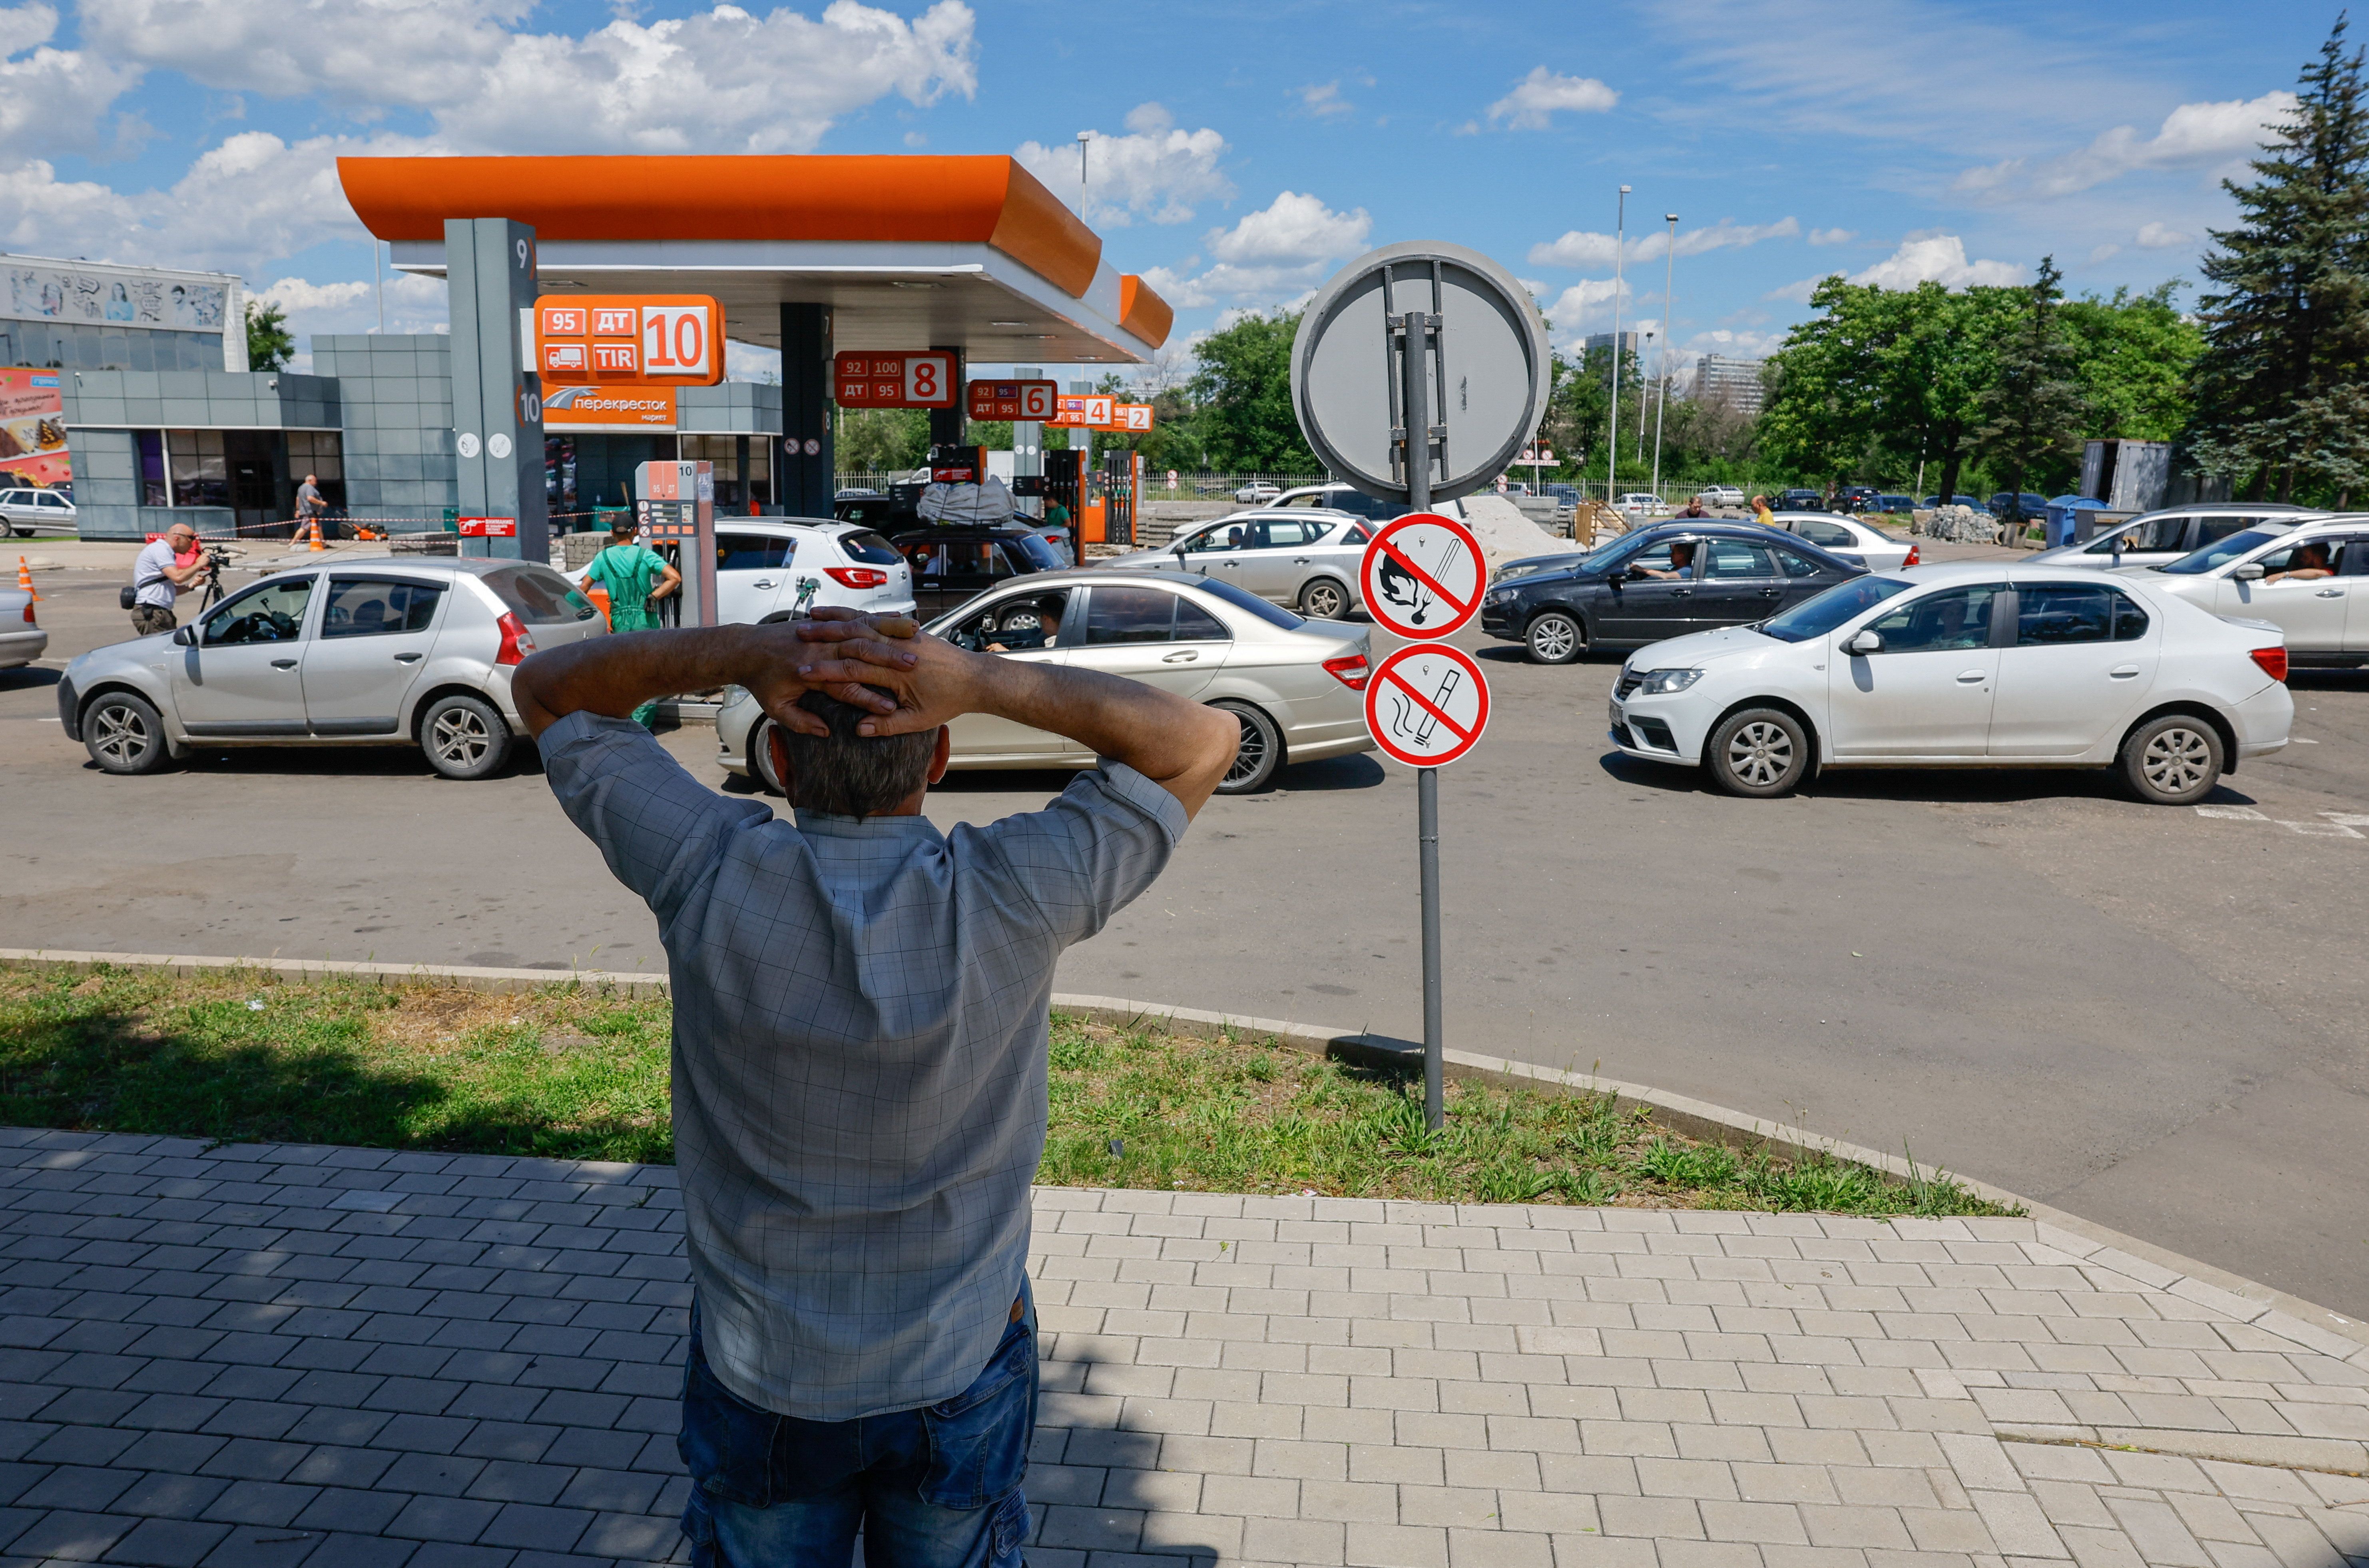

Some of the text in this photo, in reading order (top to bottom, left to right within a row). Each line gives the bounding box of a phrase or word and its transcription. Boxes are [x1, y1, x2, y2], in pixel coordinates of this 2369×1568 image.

[517, 239, 527, 269] 9
[552, 313, 575, 330] 95
[598, 313, 628, 331] ДТ
[646, 313, 703, 367] 10
[596, 349, 632, 367] TIR
[847, 362, 861, 373] 92
[875, 362, 897, 373] 100
[914, 363, 937, 397] 8
[845, 384, 864, 397] ДТ
[879, 385, 894, 396] 95
[977, 387, 989, 396] 92
[520, 393, 540, 422] 10
[575, 399, 667, 412] перекресток
[976, 404, 991, 413] ДТ
[1001, 404, 1013, 413] 95
[1027, 388, 1044, 414] 6
[1091, 402, 1105, 421] 4
[1134, 410, 1144, 427] 2
[825, 411, 831, 430] 8
[679, 466, 692, 476] 10
[668, 485, 675, 493] ДТ
